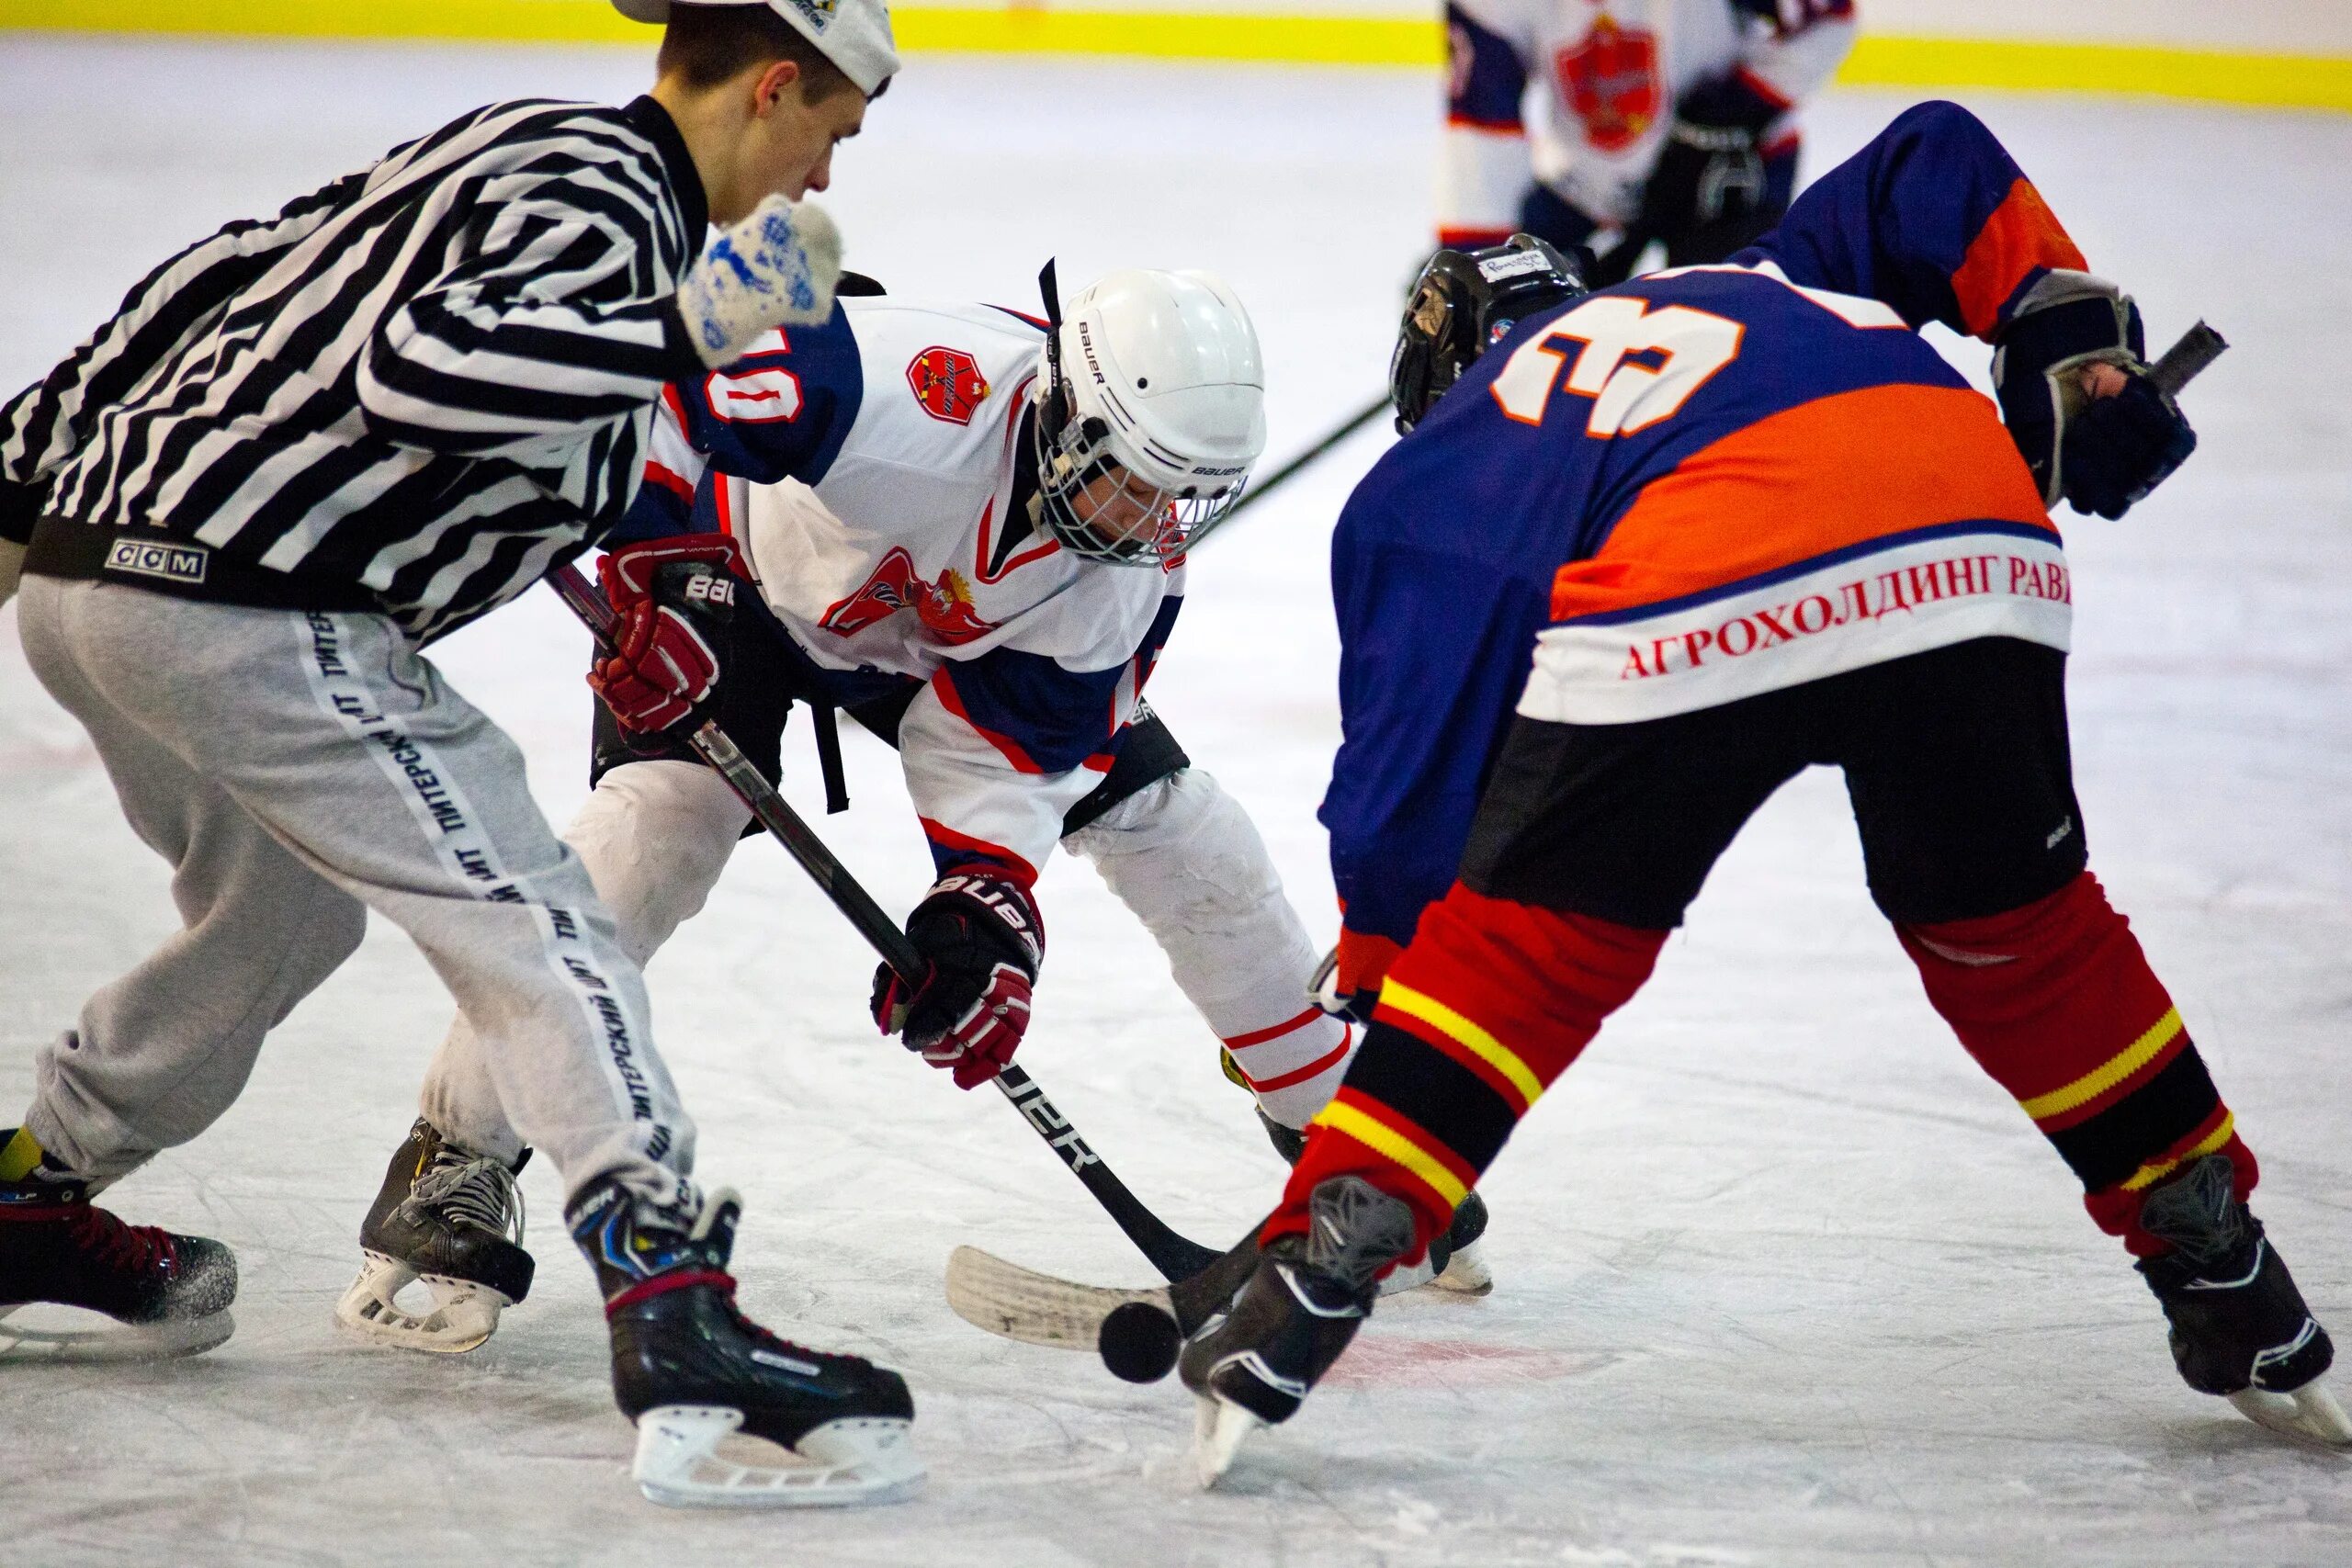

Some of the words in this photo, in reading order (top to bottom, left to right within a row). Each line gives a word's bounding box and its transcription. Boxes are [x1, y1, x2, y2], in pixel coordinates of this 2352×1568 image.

[1079, 321, 1105, 385] BAUER
[1191, 466, 1246, 477] BAUER
[117, 546, 199, 573] CCM
[1620, 555, 1999, 681] АГРОХОЛДИНГ
[413, 1131, 424, 1143] 27
